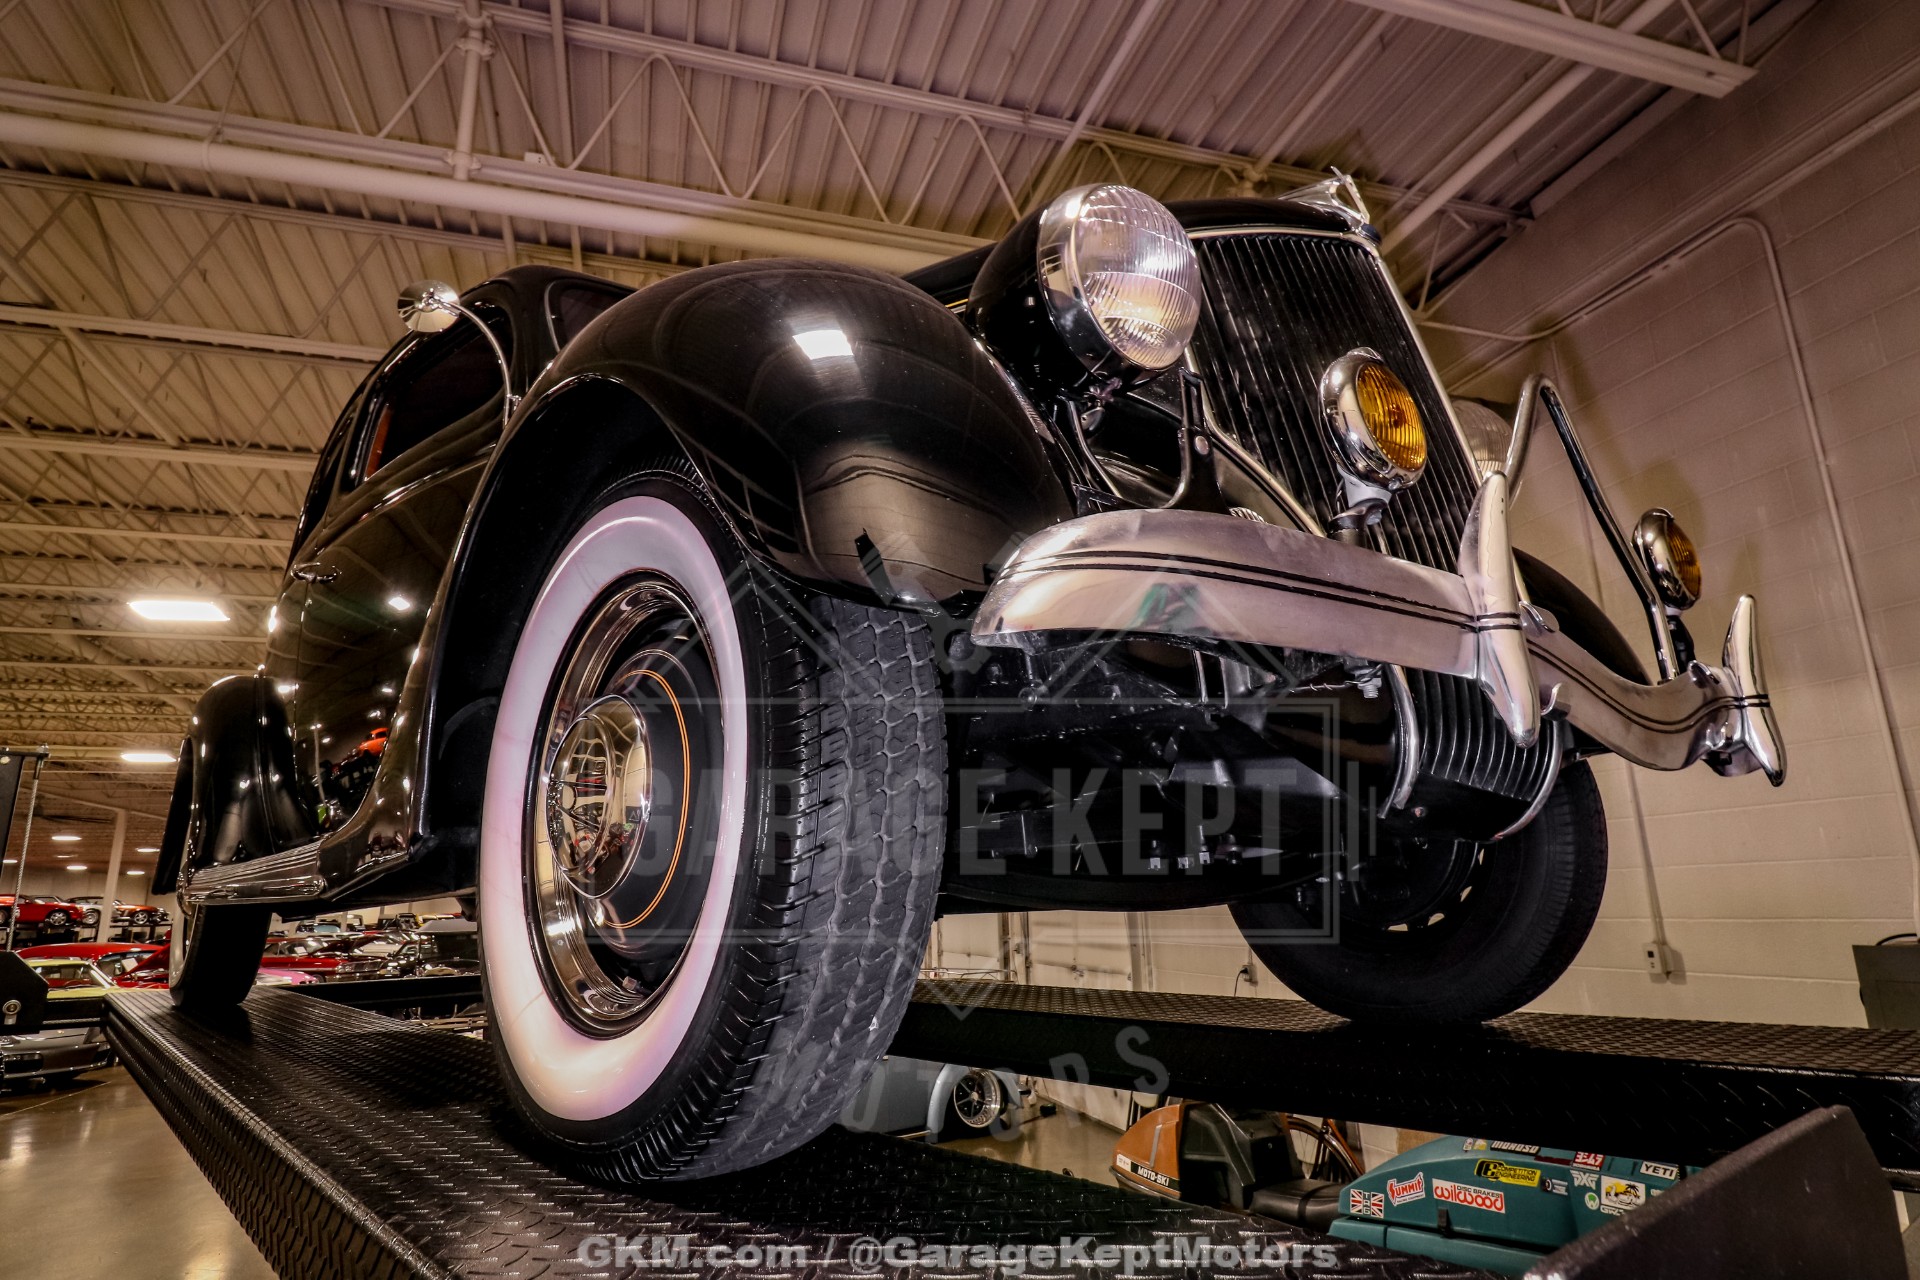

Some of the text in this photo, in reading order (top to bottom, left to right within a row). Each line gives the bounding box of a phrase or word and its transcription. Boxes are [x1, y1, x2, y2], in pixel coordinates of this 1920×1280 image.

[1137, 1165, 1170, 1187] MOTO-SKI
[1494, 1170, 1536, 1182] ENGINEERING
[1497, 1164, 1537, 1176] COMPETITION
[1644, 1164, 1676, 1177] YETI
[1434, 1185, 1503, 1211] wilwood
[1456, 1185, 1500, 1199] DISC BRAKES
